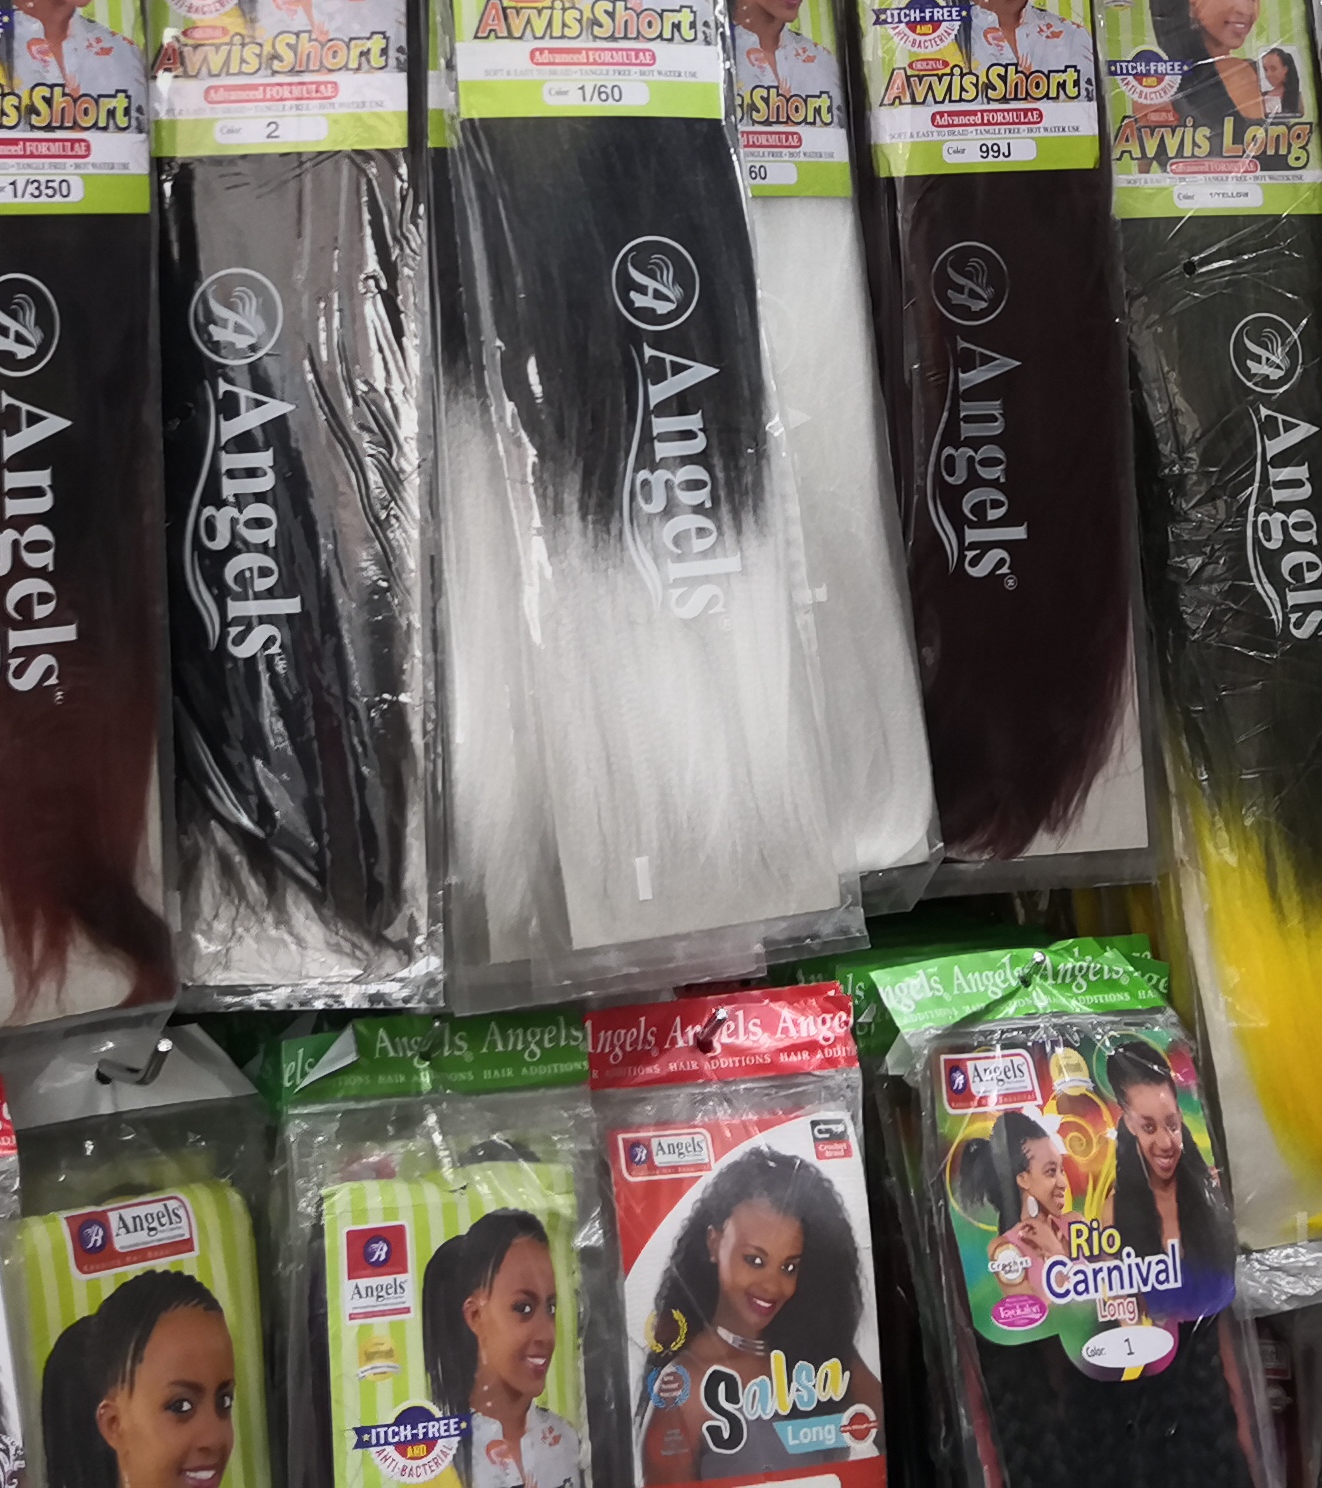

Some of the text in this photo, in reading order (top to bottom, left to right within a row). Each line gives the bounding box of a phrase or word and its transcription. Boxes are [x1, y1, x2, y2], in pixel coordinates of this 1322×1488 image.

[886, 7, 962, 23] ITCH-FREE
[915, 23, 934, 35] AND
[890, 22, 956, 50] ANTI-BACTERIAL
[152, 29, 390, 79] Avvis Short
[1115, 61, 1182, 76] ITCH-FREE
[576, 83, 624, 104] 1/60
[879, 62, 1082, 107] Avvis Short
[29, 83, 133, 132] Short
[747, 85, 833, 125] Short
[933, 109, 1041, 126] Advanced FORMULAE
[264, 120, 282, 141] 2
[1114, 115, 1314, 171] Avvis Long
[979, 141, 1012, 160] 99J
[7, 177, 73, 201] 1/350
[940, 334, 1028, 579] Angels
[639, 341, 744, 622] Angels
[200, 375, 304, 662] Angels
[480, 1015, 586, 1062] Angels
[482, 1059, 590, 1081] HAIR ADDITIONS
[668, 1048, 811, 1073] HAIR ADDITIONS HAIR
[971, 1061, 1027, 1088] Angels
[655, 1134, 705, 1157] Angels
[114, 1202, 186, 1239] Angels
[1068, 1220, 1123, 1260] Rio
[1042, 1239, 1183, 1305] Carnival
[349, 1277, 407, 1302] Angels
[1095, 1296, 1138, 1324] Long
[1124, 1338, 1136, 1356] 1
[700, 1349, 851, 1455] Salsa
[371, 1417, 461, 1445] ITCH-FREE
[786, 1422, 836, 1445] Long
[375, 1443, 454, 1480] ANTI-BACTERIAL
